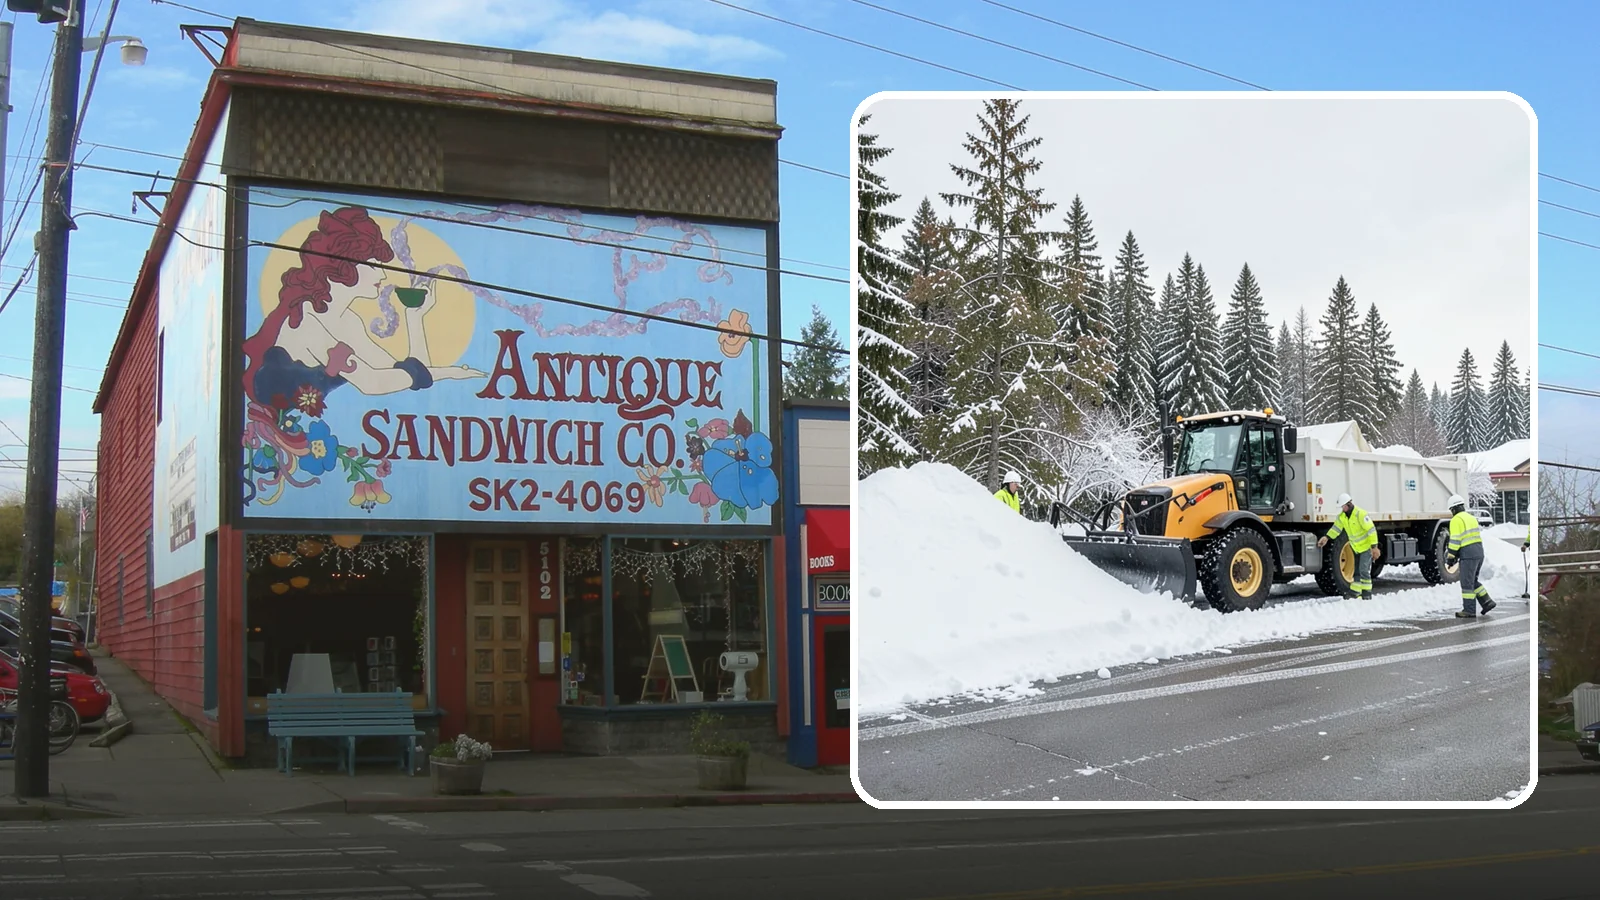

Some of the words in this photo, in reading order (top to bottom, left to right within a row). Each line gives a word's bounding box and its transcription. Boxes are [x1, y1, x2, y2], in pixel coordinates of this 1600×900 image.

[476, 329, 724, 420] ANTIQUE
[362, 409, 604, 467] SANDWICH
[617, 422, 685, 469] CO.
[468, 477, 646, 513] SK2-4069
[540, 541, 551, 599] 5102
[809, 555, 835, 569] BOOKS
